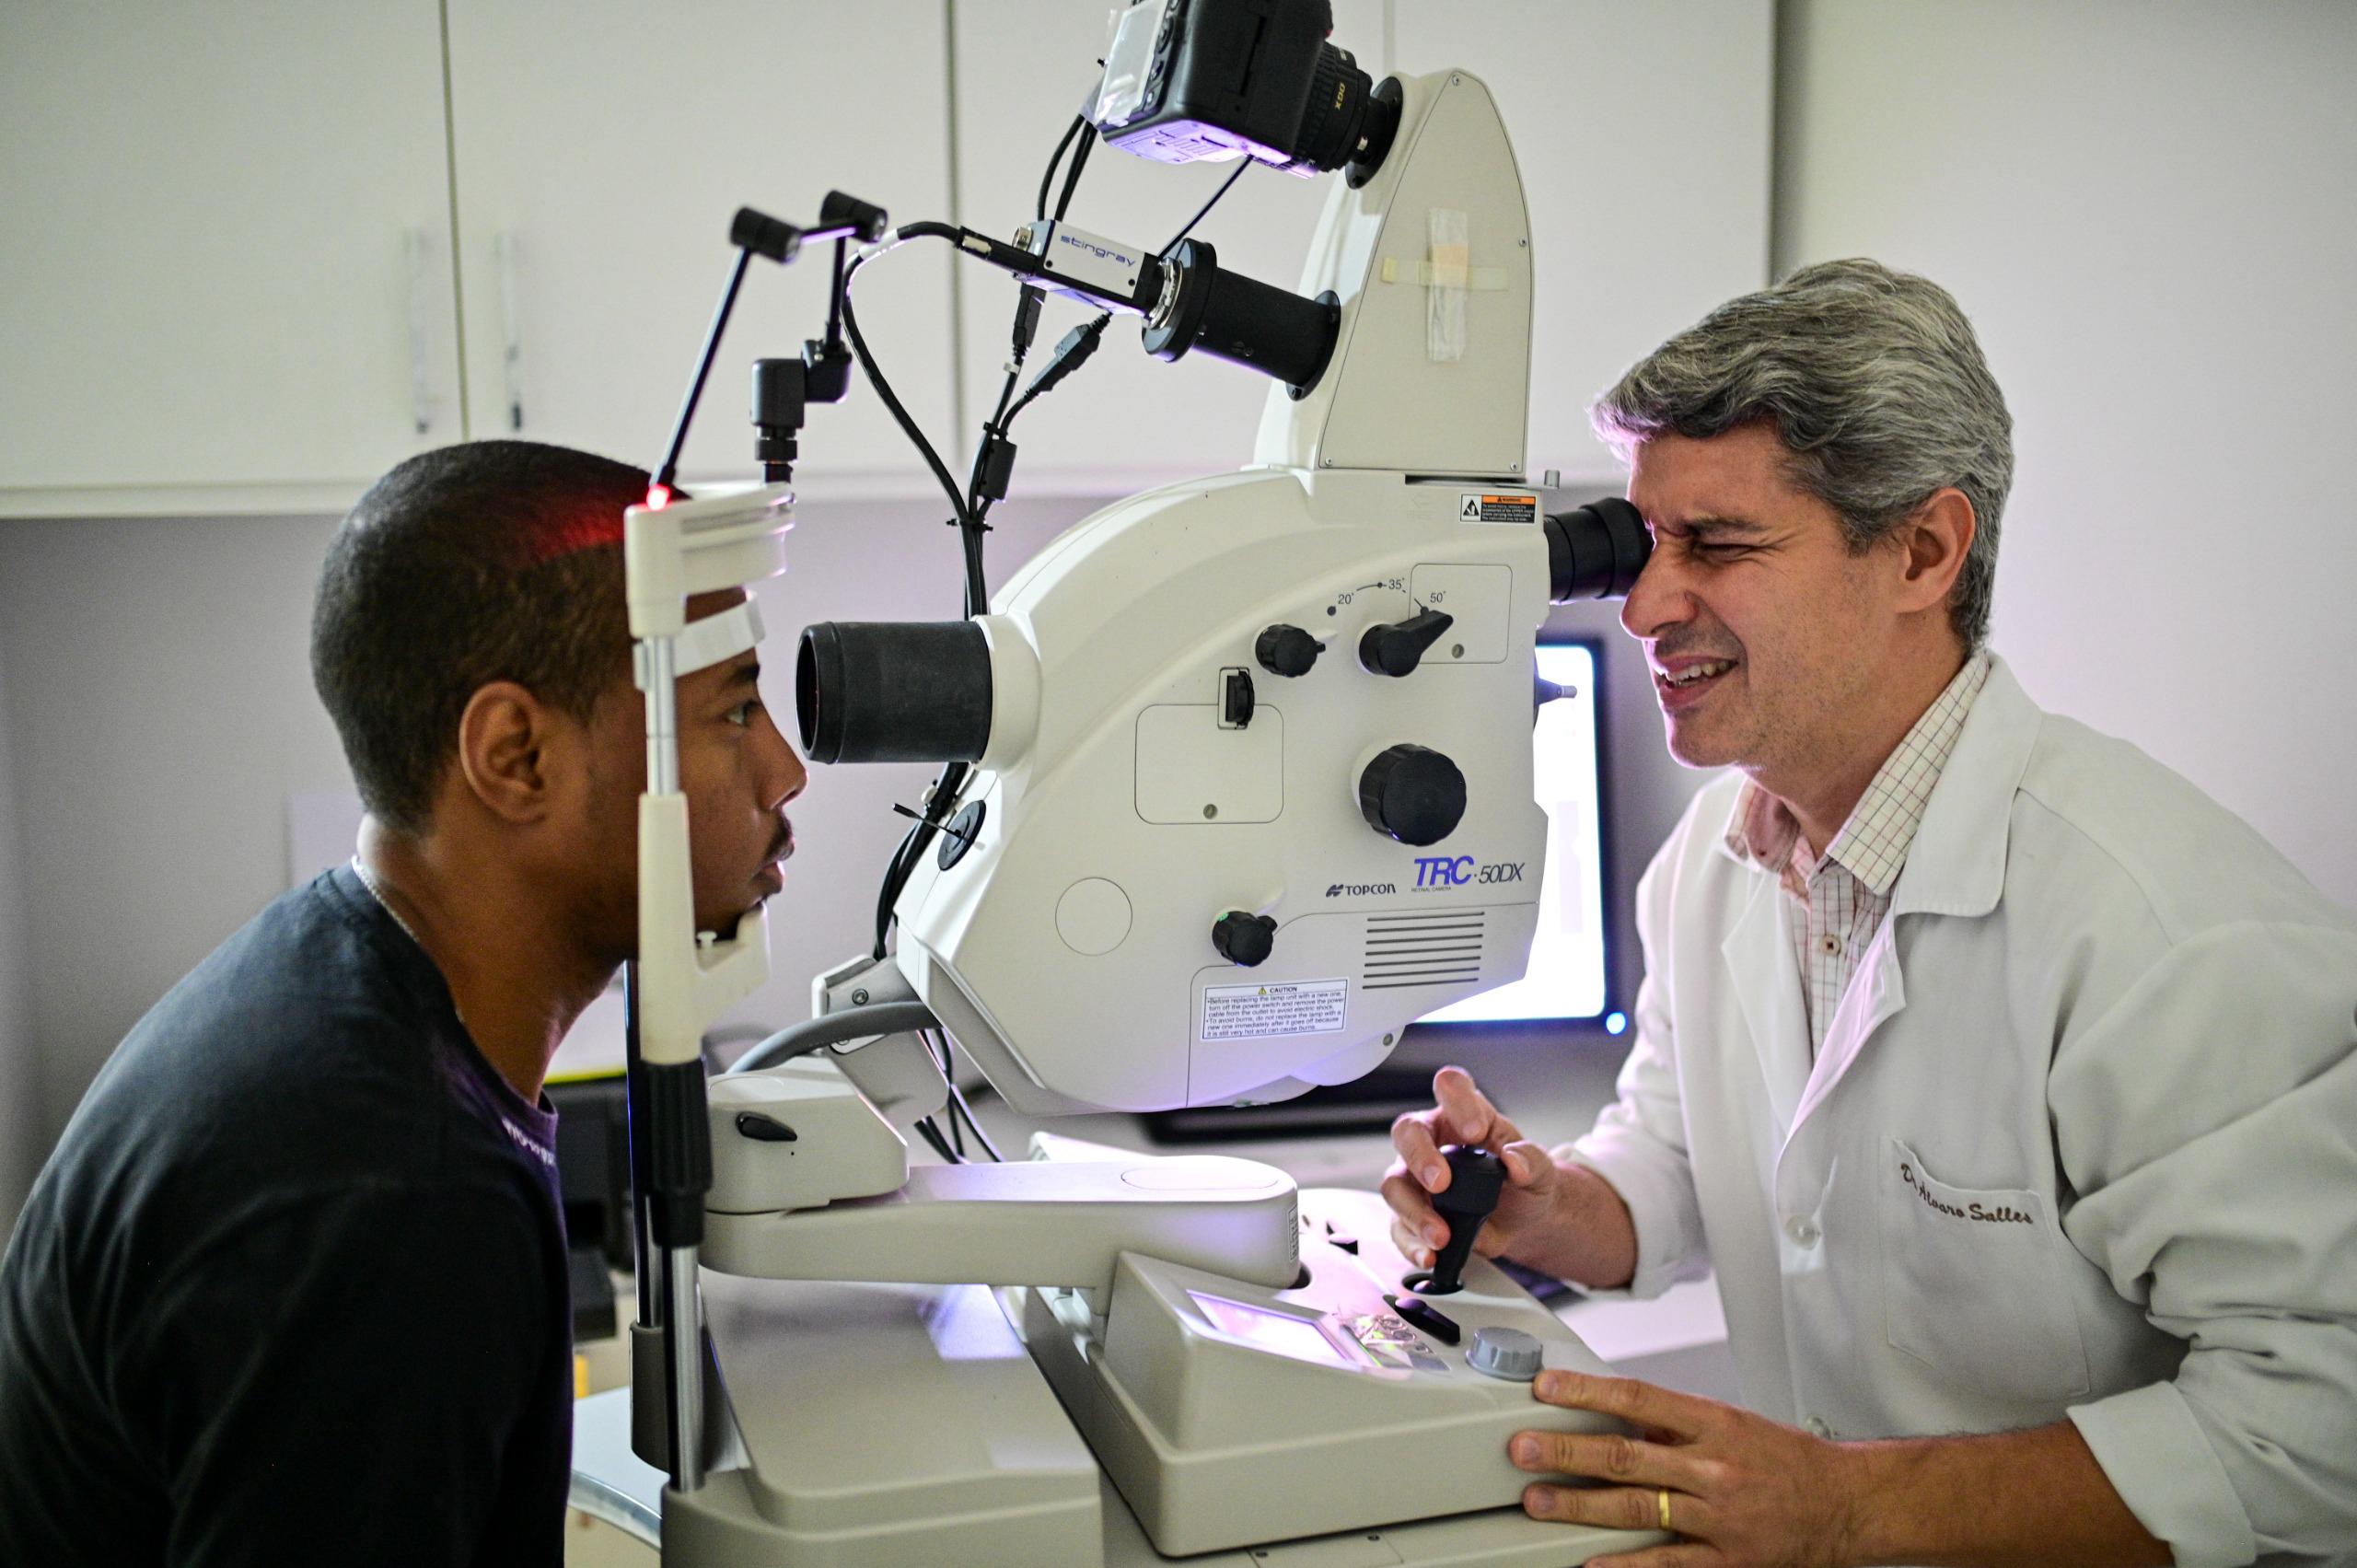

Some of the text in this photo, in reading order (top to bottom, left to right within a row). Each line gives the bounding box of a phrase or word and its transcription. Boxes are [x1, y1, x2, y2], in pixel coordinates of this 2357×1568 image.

[1061, 235, 1135, 267] stingray
[1345, 883, 1397, 896] TOPCON
[1968, 1202, 2033, 1225] Salles
